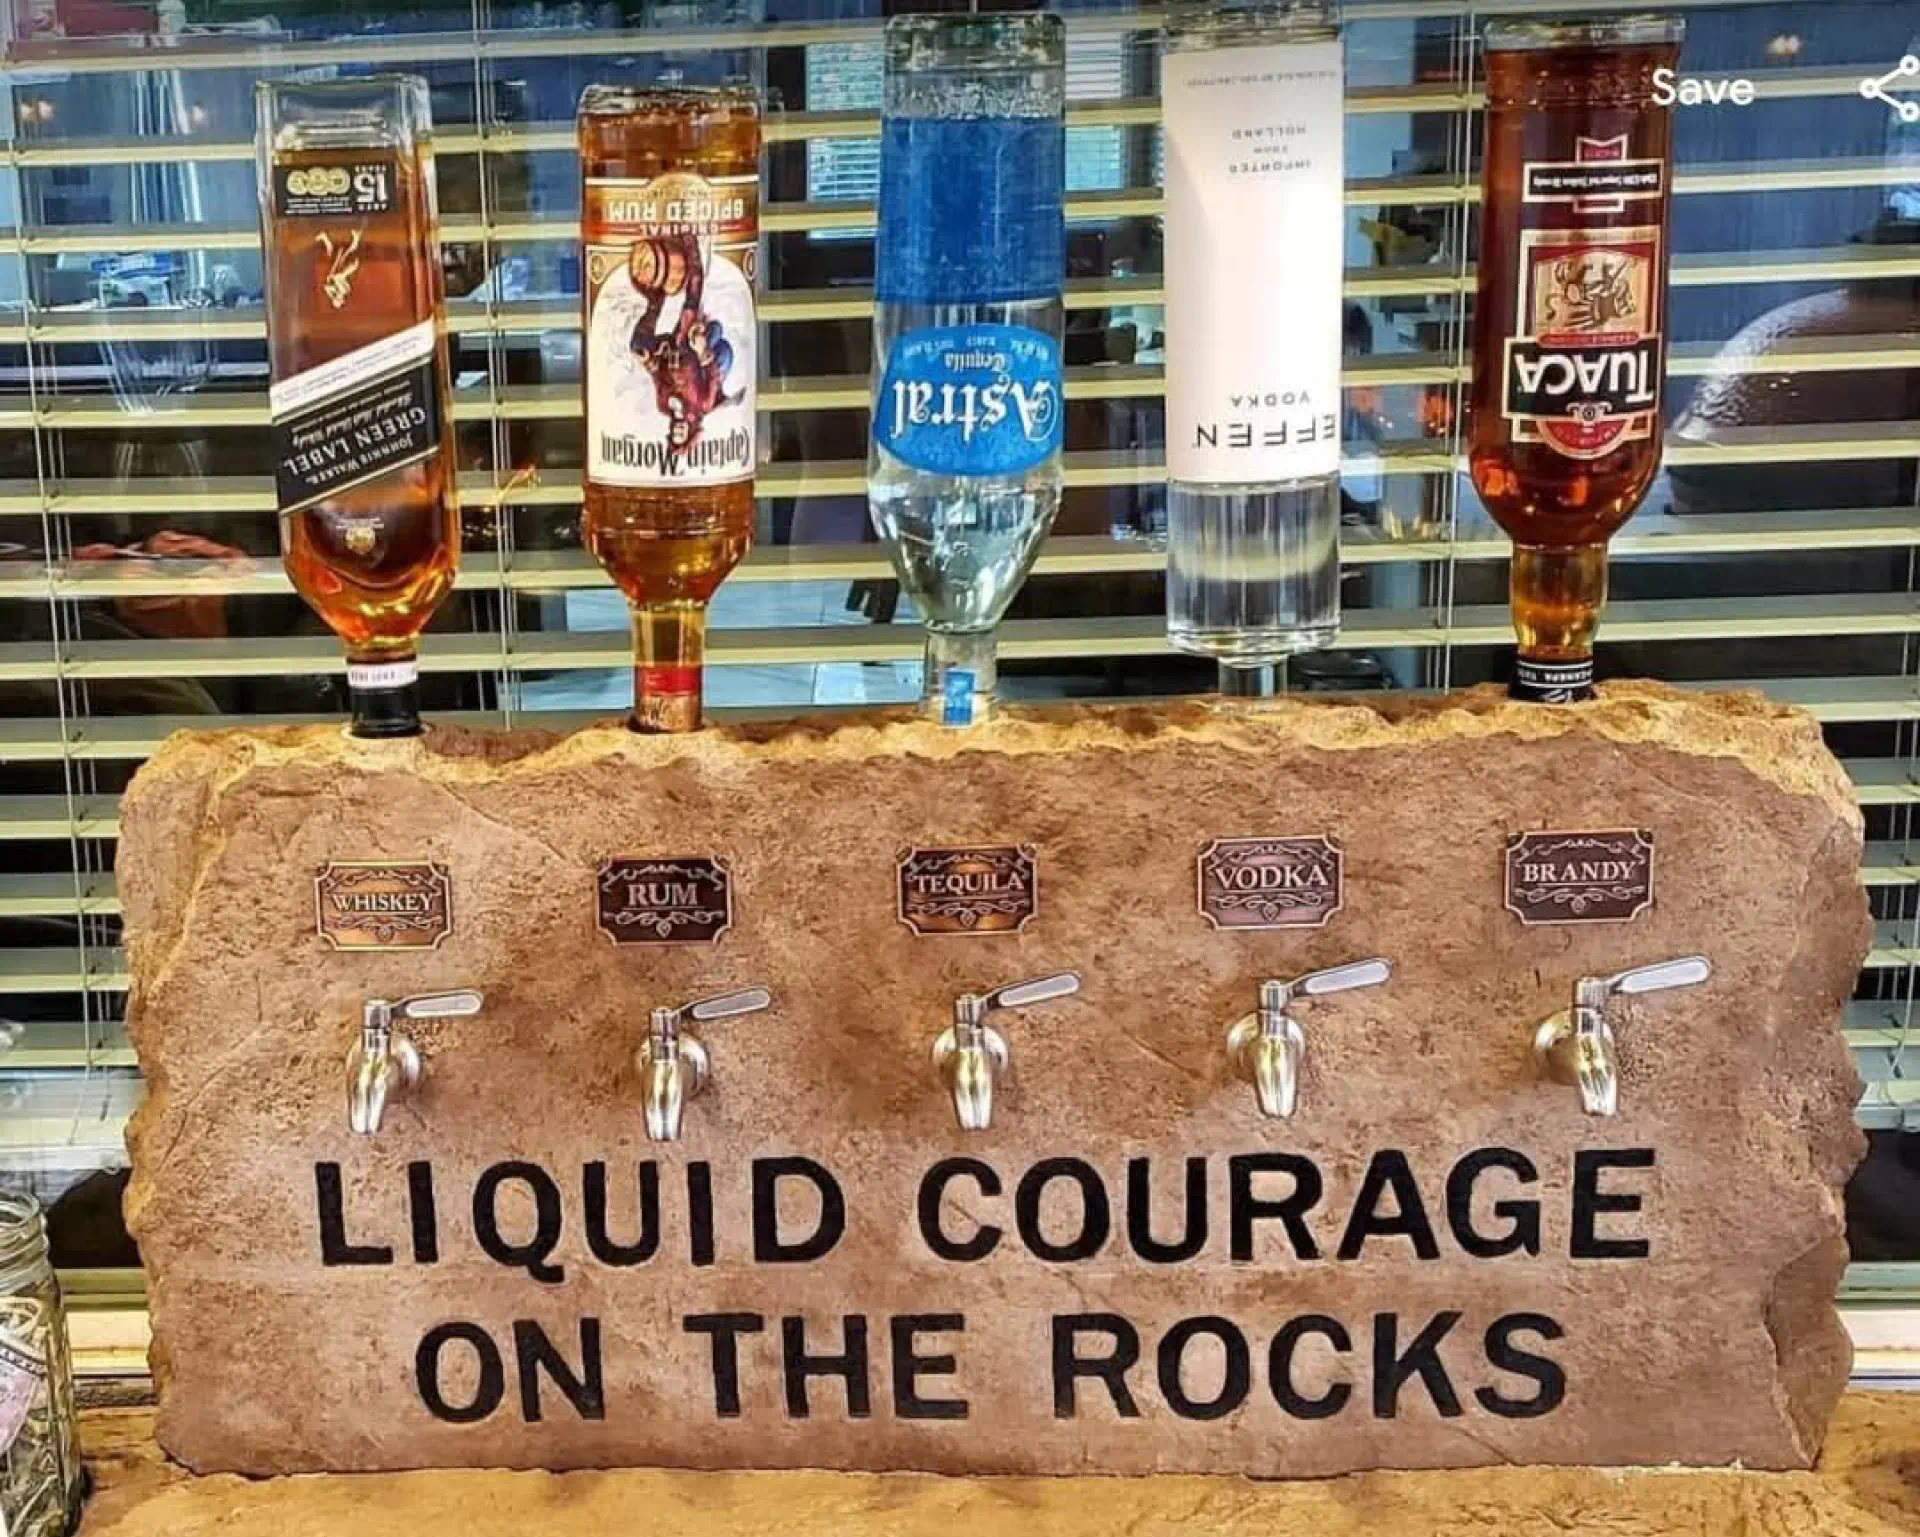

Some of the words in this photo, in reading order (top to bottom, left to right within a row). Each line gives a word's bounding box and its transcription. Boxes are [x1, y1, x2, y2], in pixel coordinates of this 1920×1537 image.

[1231, 126, 1306, 140] HOLLAND
[353, 171, 389, 202] 15
[608, 200, 657, 222] RUM
[666, 198, 745, 222] SPICED
[639, 222, 720, 237] ORIGINAL
[944, 350, 1011, 374] Tequila
[890, 373, 1057, 443] Astral
[1230, 390, 1310, 408] VODKA
[354, 406, 427, 449] GREEN
[1195, 414, 1337, 449] EFFEN
[282, 436, 350, 476] LABEL
[359, 432, 414, 467] JOHNNIE
[601, 431, 684, 477] Morgan
[686, 425, 750, 475] Captain
[304, 457, 361, 485] WALKER
[911, 871, 1025, 895] TEQUILA
[1215, 864, 1329, 889] VODKA
[1522, 861, 1636, 882] BRANDY
[331, 893, 433, 911] WHISKEY
[628, 882, 698, 906] RUM
[314, 1156, 846, 1284] LIQUID
[917, 1147, 1656, 1263] COURAGE
[414, 1314, 605, 1422] ON
[682, 1313, 969, 1419] THE
[1052, 1310, 1567, 1421] ROCKS
